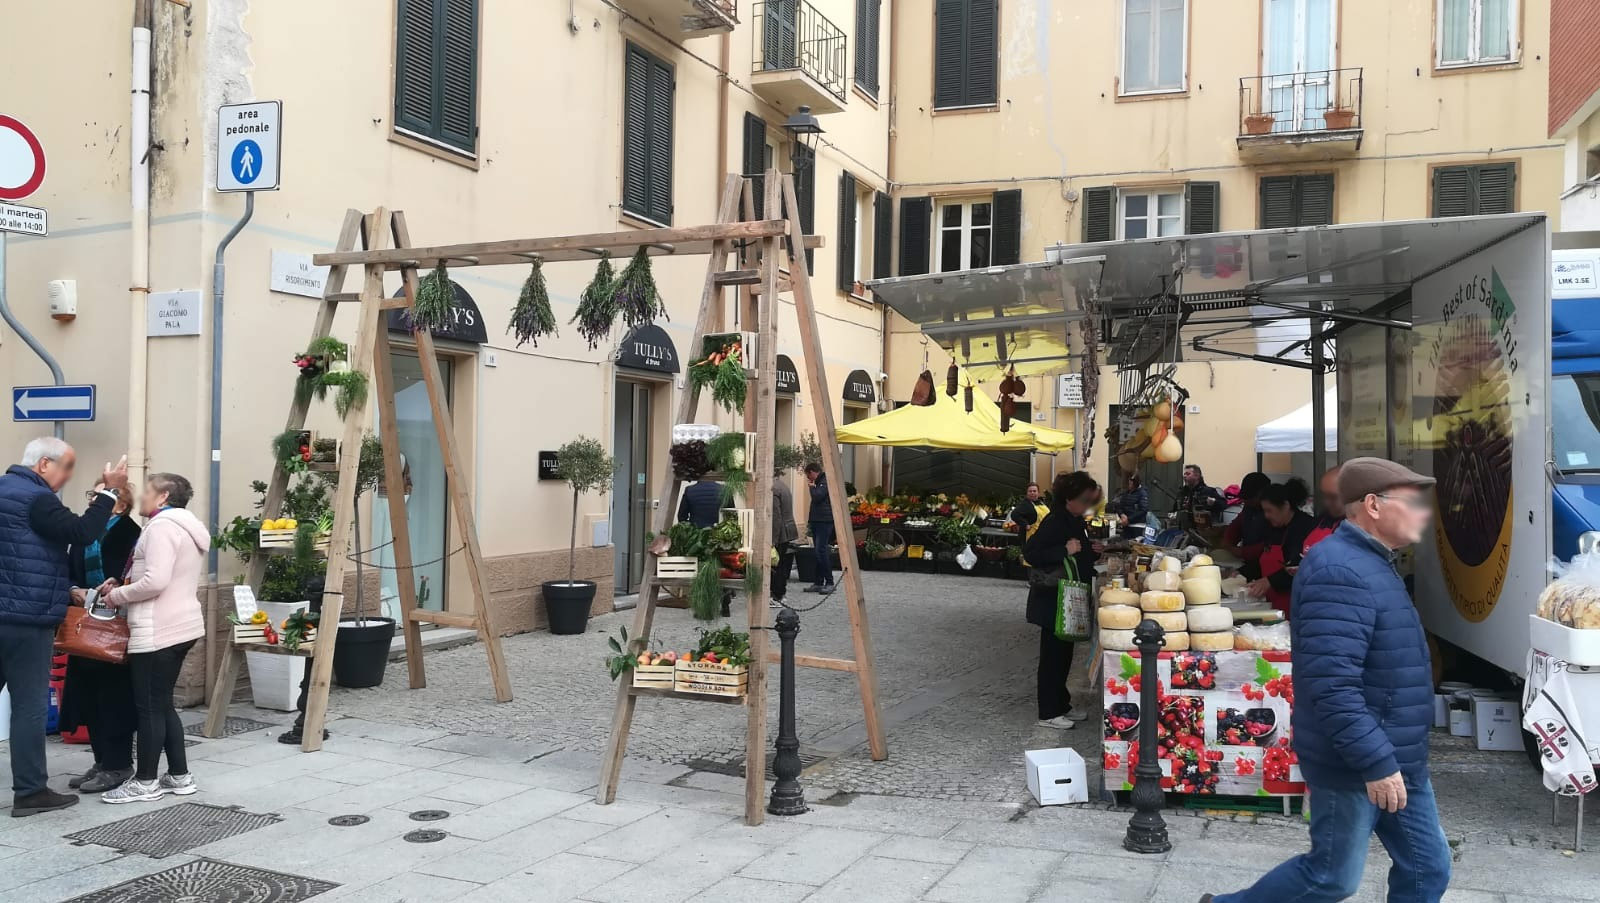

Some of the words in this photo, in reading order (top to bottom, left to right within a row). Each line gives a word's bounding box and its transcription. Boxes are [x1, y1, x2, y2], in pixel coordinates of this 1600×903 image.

[238, 110, 258, 119] area
[226, 122, 270, 136] pedonale
[7, 209, 43, 220] martedì
[8, 218, 21, 228] alle
[24, 221, 43, 231] 14:00
[299, 263, 308, 272] VIA
[158, 309, 188, 318] GIACOMO
[1442, 283, 1463, 327] Best
[1465, 274, 1478, 301] of
[1479, 277, 1518, 377] Sardinia
[633, 341, 673, 361] TULLY'S
[852, 382, 872, 395] TULLY'S
